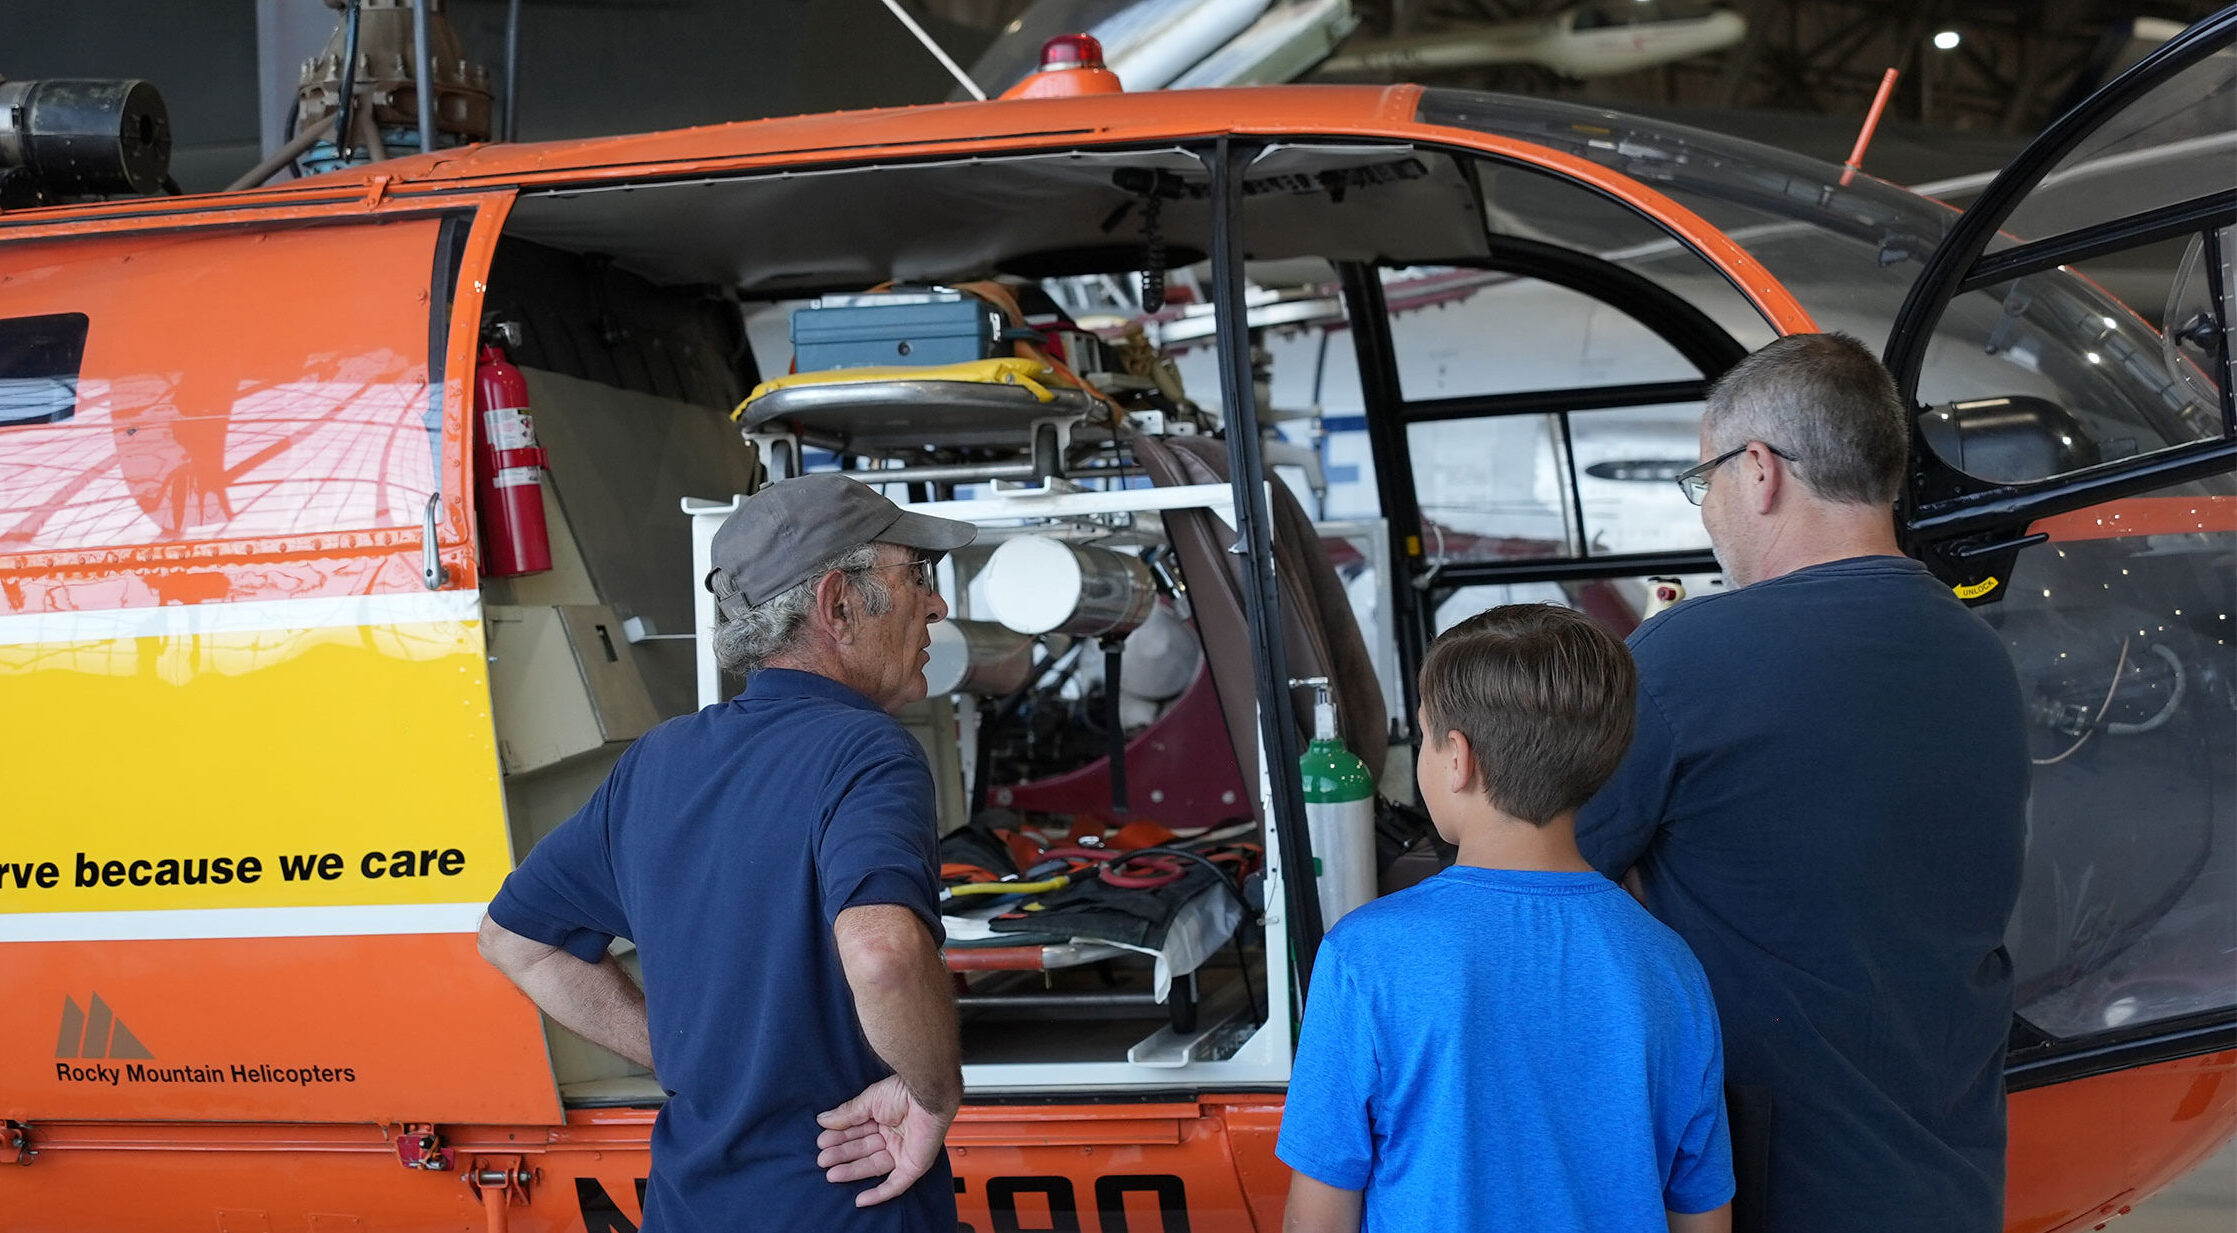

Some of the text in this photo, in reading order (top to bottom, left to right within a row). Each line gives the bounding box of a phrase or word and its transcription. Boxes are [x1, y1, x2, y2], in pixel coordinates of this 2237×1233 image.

[1963, 580, 1994, 596] UNLOCK
[75, 852, 263, 887] because
[279, 853, 344, 881] we
[360, 847, 466, 878] care
[56, 1062, 356, 1087] Rocky Mountain Helicopters
